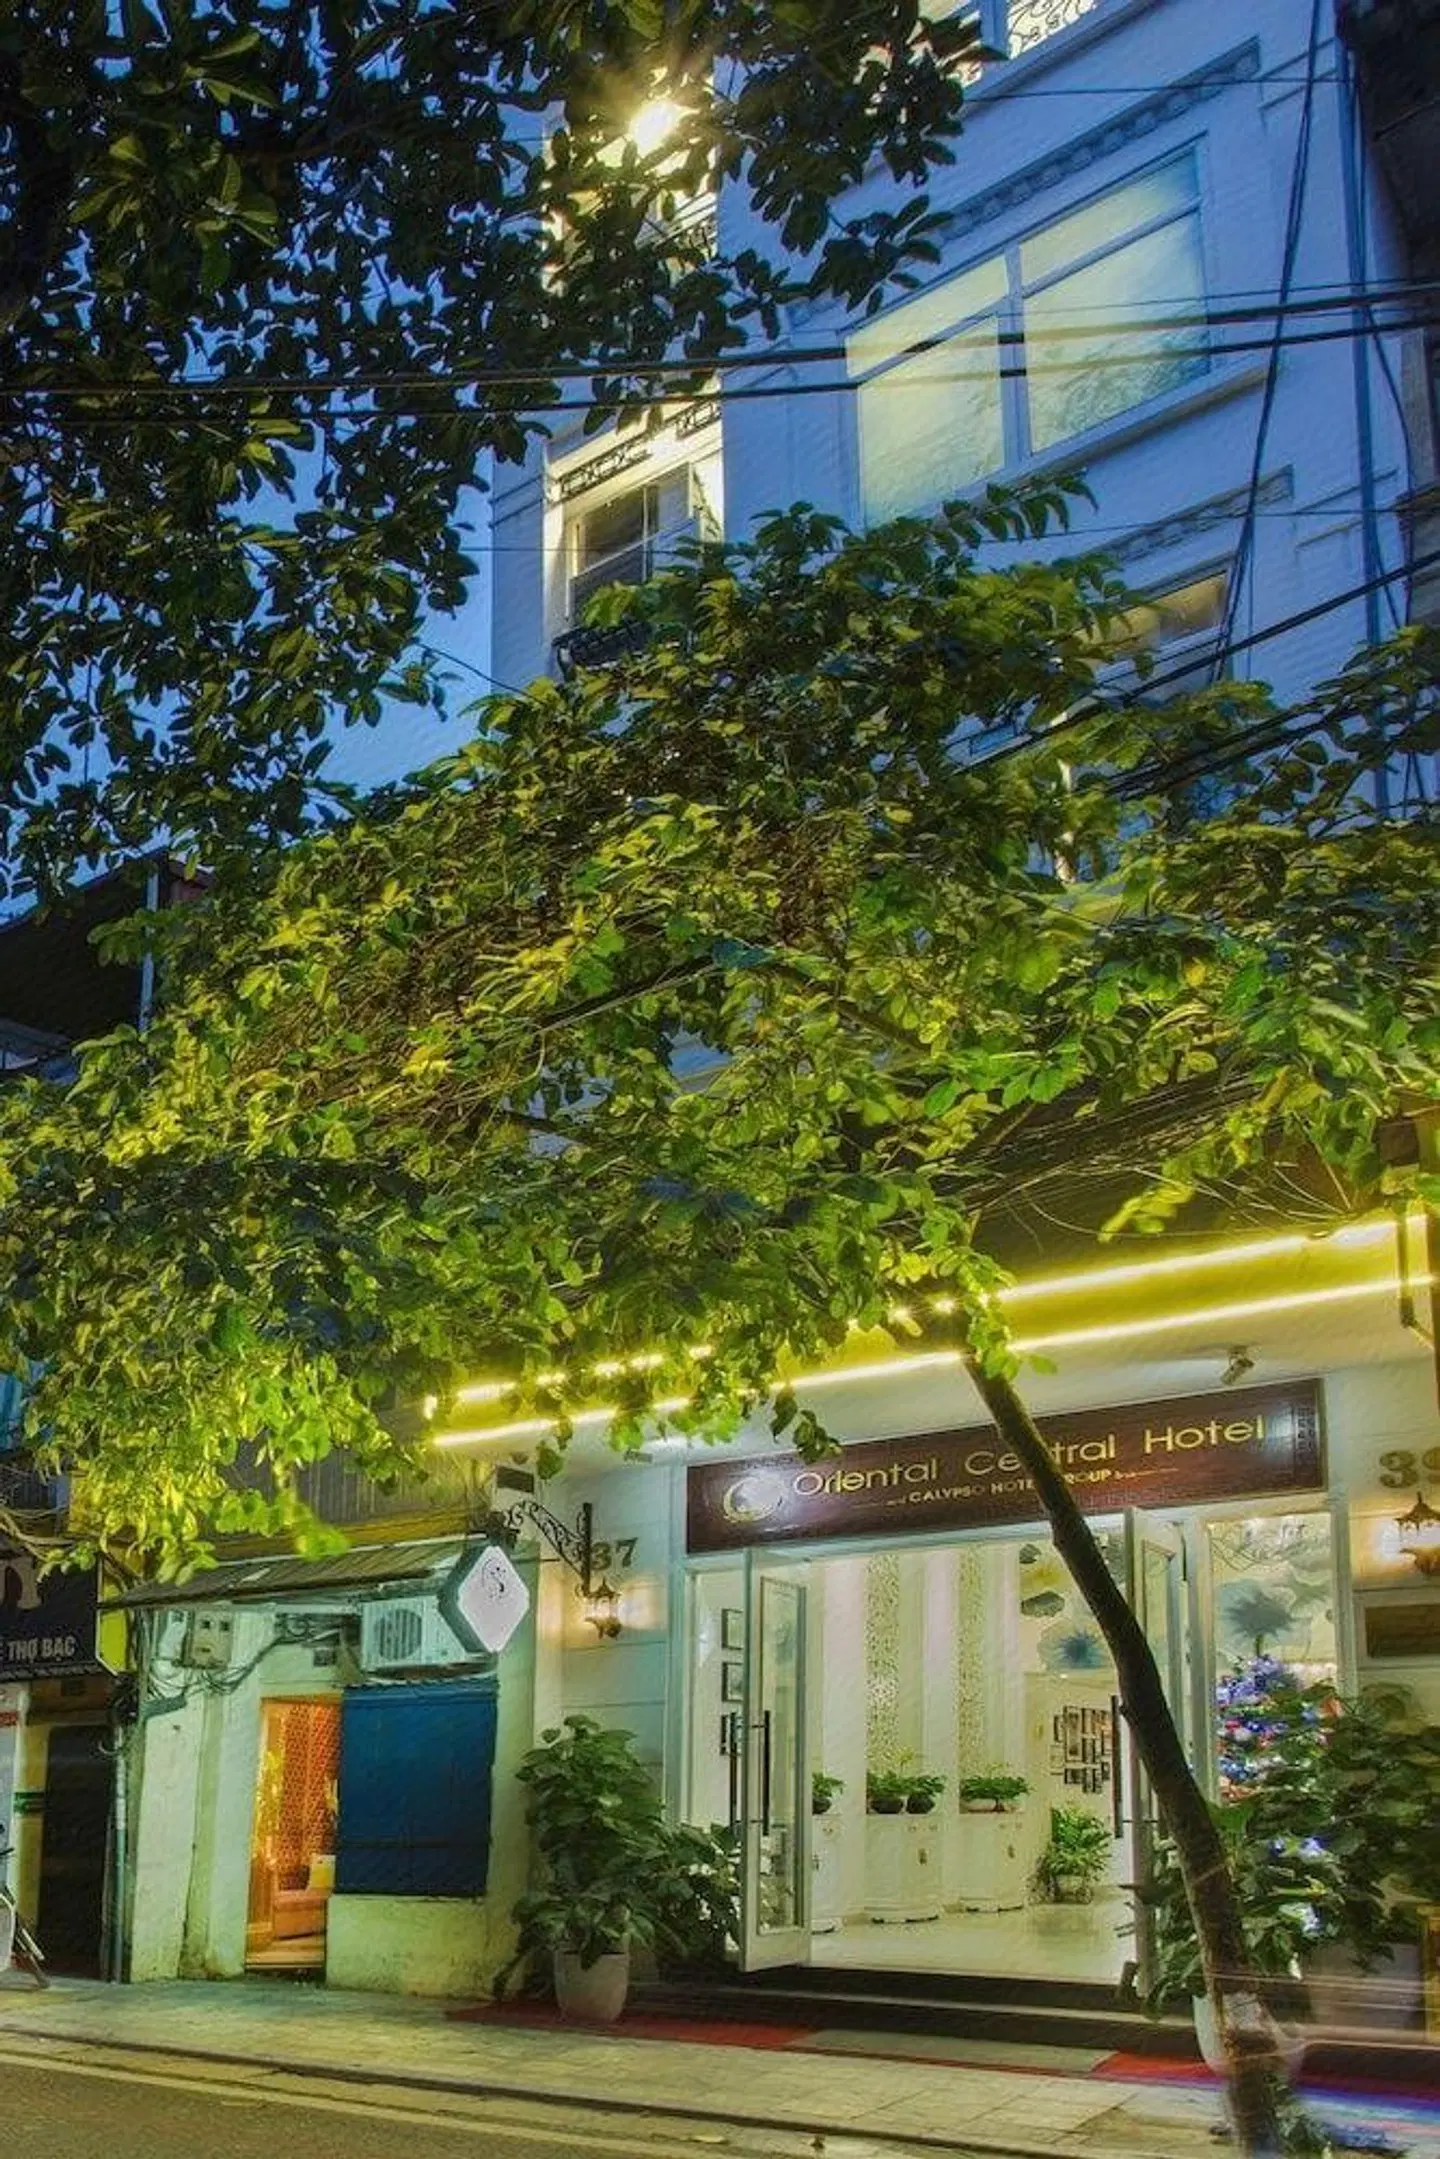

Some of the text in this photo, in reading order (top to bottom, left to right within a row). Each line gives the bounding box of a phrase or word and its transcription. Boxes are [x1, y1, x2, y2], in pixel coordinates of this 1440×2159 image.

[794, 1457, 937, 1495] Oriental
[965, 1434, 1116, 1475] Cetral
[1145, 1415, 1264, 1455] Hotel
[909, 1468, 1114, 1503] CALYPSO HOTE ROUP
[590, 1536, 639, 1571] 37
